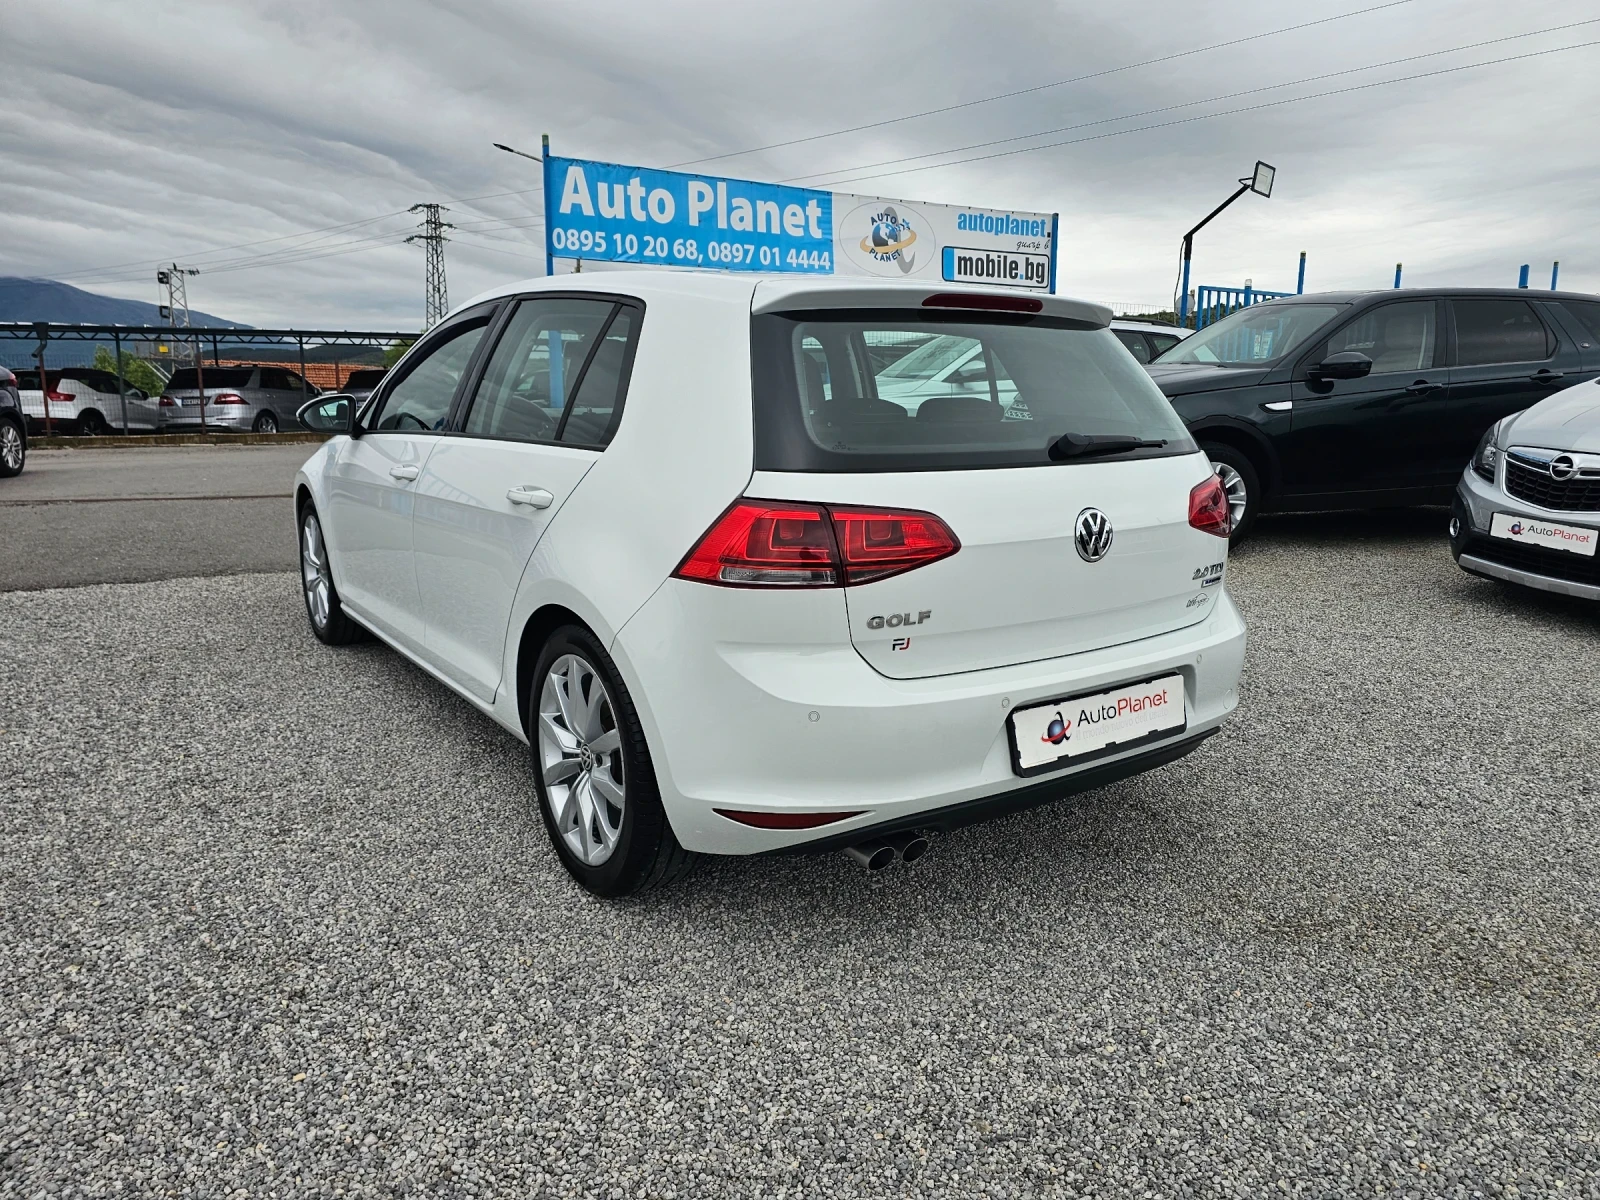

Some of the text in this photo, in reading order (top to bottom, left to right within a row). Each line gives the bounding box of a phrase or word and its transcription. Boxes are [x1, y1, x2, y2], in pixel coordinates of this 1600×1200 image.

[559, 165, 823, 239] Auto Planet
[870, 212, 897, 226] AUTO
[552, 227, 831, 270] 0895 10 20 68, 0897 01 4444
[869, 247, 901, 262] PLANET
[957, 253, 1046, 284] mobile.bg
[1527, 524, 1591, 543] AutoPlanet
[866, 609, 932, 630] GOLF
[1077, 689, 1168, 727] AutoPlanet
